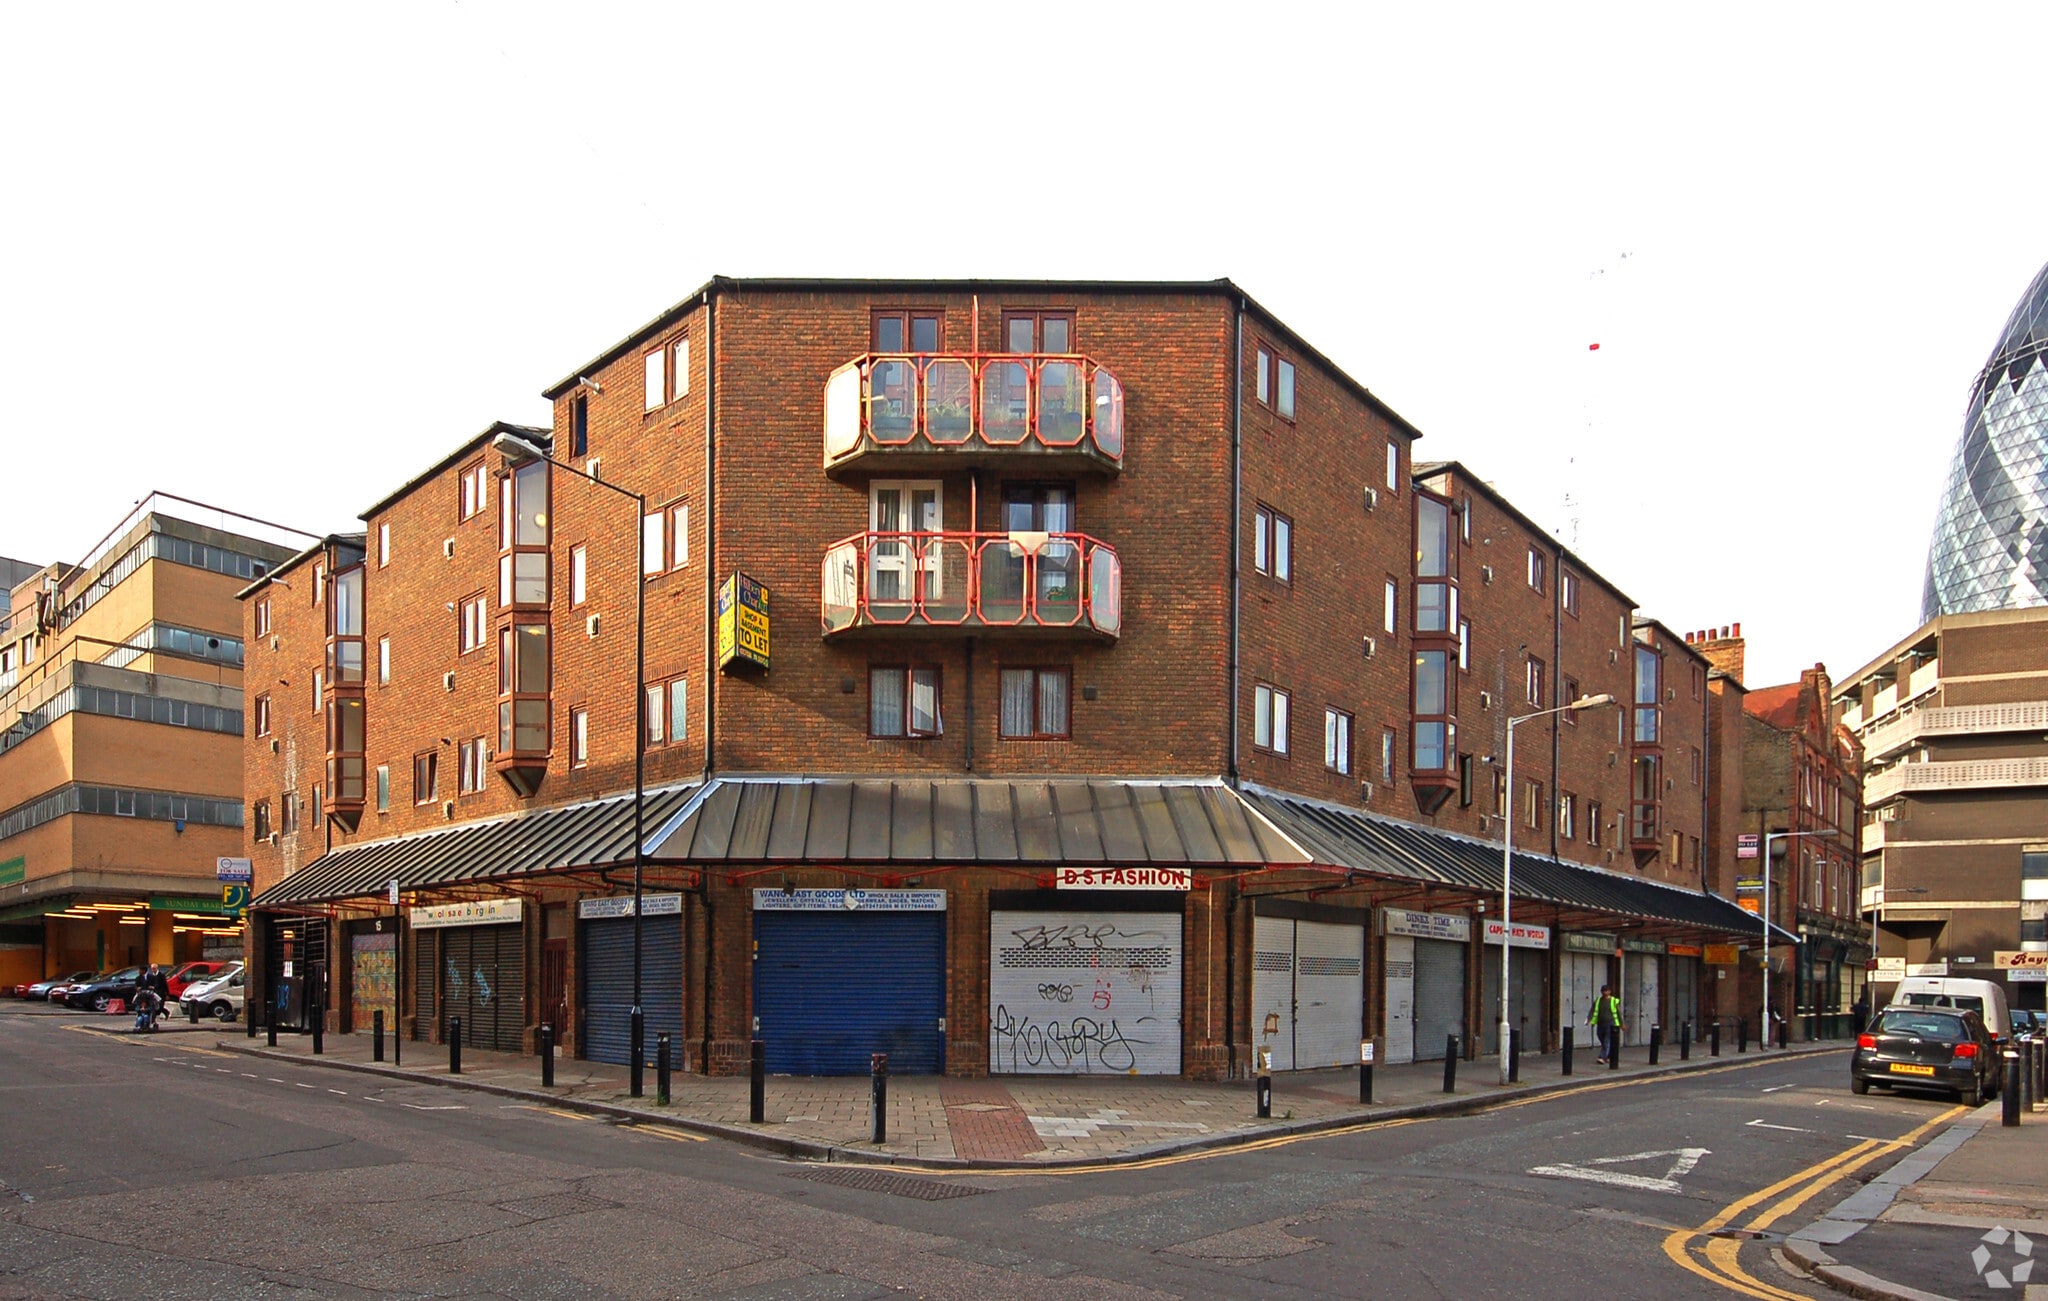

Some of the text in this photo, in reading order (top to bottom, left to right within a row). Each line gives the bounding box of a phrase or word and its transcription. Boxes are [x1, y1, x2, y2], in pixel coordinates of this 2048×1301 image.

[741, 628, 768, 653] TO LET
[1100, 869, 1185, 885] FASHION
[788, 890, 813, 898] AST
[1433, 916, 1451, 927] TIME
[1512, 927, 1525, 938] HATS
[1527, 929, 1545, 940] WORLD
